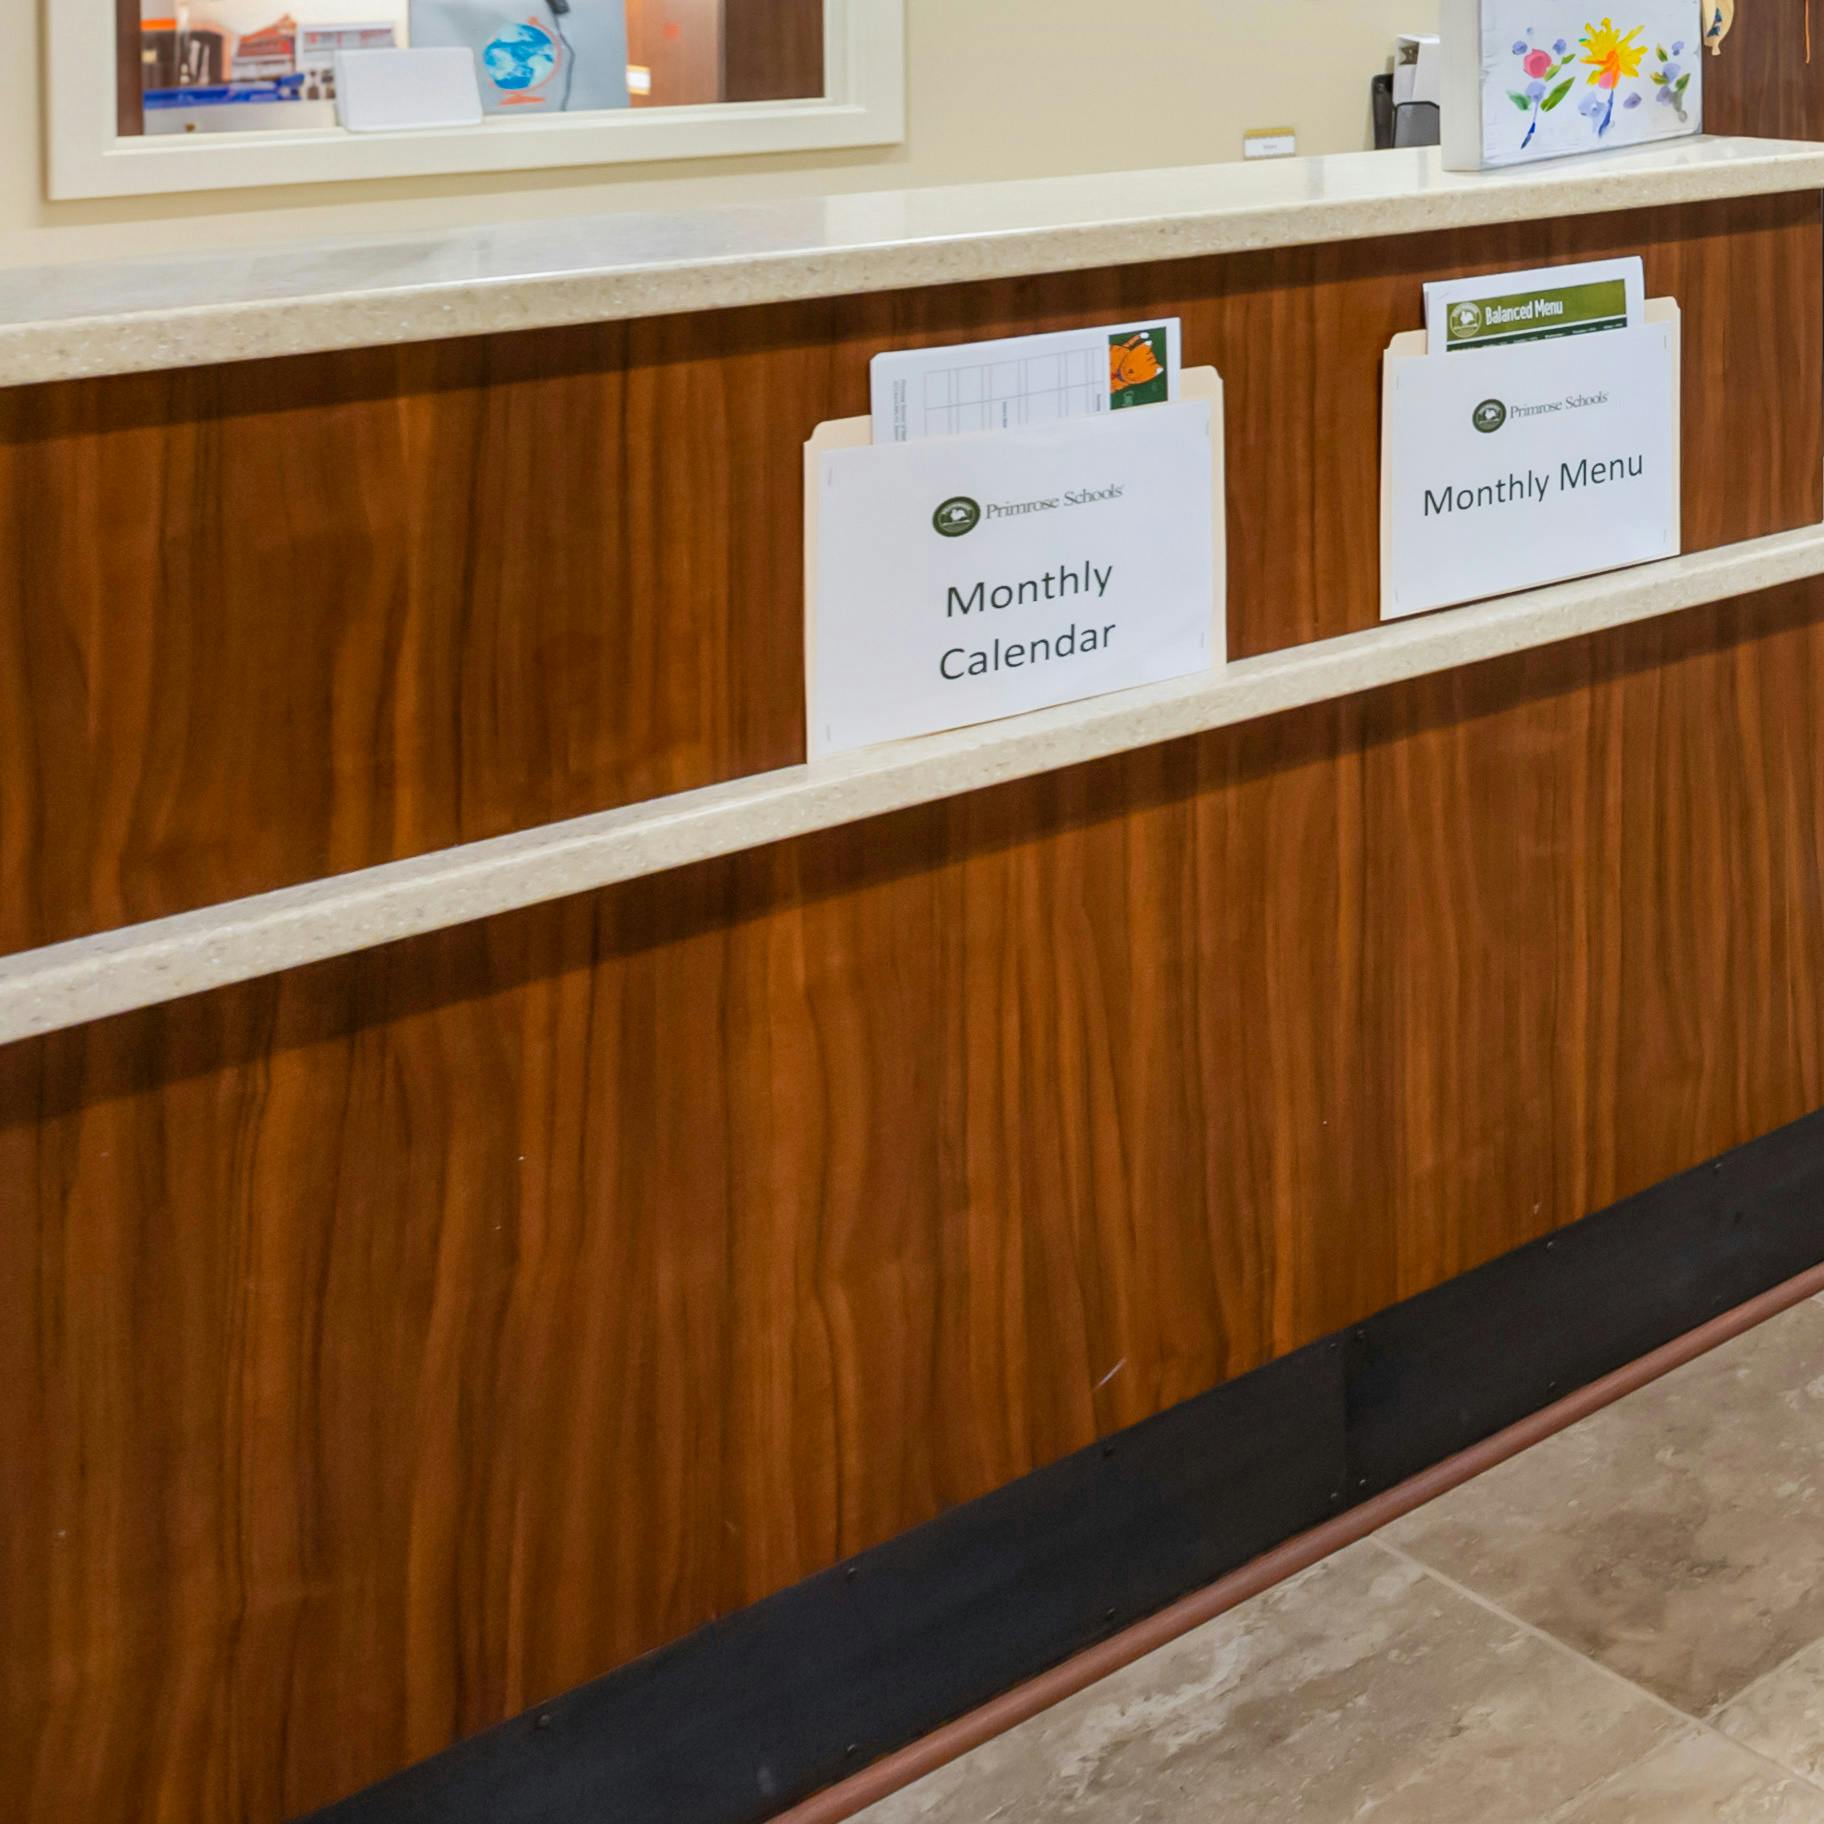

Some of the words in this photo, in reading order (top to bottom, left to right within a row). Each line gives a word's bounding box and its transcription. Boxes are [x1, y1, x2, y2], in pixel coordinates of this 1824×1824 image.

[1485, 300, 1533, 326] Balanced
[1534, 298, 1564, 318] Menu
[1509, 400, 1563, 420] Primrose
[1565, 390, 1608, 410] Schools
[985, 495, 1060, 520] Primrose
[1062, 483, 1124, 507] Schools
[1424, 469, 1549, 517] Monthly
[1559, 453, 1643, 491] Menu
[946, 559, 1114, 618] Monthly
[939, 623, 1117, 681] Calendar
